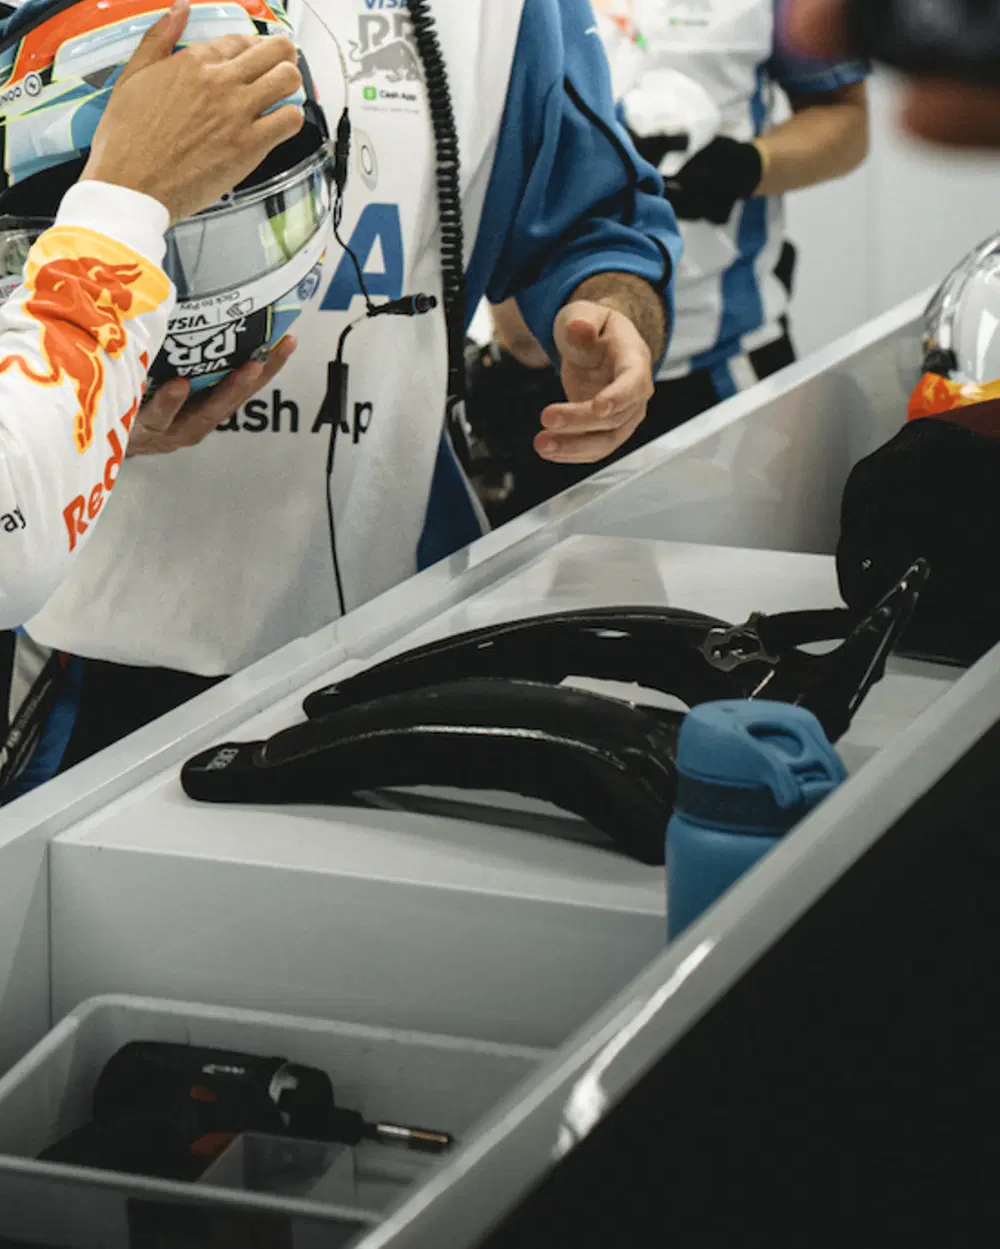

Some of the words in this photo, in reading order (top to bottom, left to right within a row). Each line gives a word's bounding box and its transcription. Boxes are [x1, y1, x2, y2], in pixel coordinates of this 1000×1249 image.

[167, 314, 211, 331] VISA
[176, 357, 229, 376] VISA
[63, 428, 123, 552] Red
